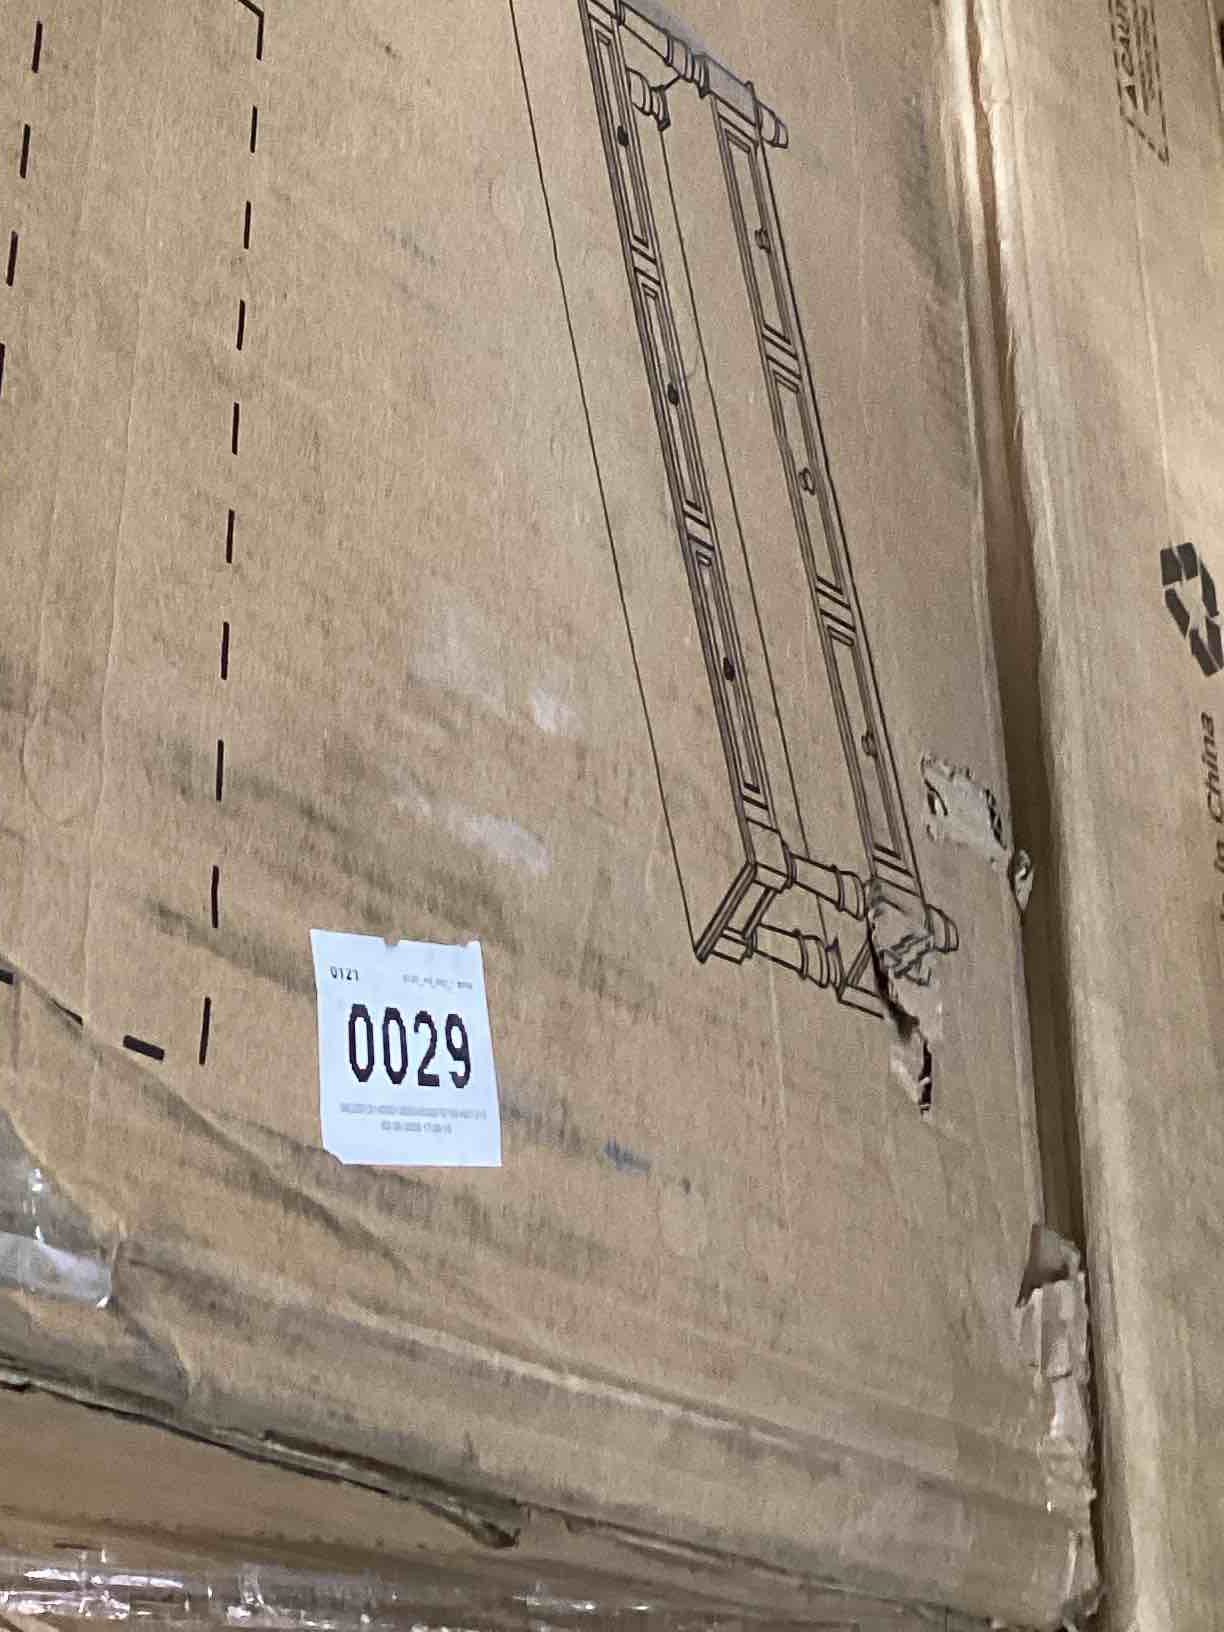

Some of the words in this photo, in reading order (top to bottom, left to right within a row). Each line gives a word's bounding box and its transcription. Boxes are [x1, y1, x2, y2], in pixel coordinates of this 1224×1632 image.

[1200, 711, 1224, 824] China
[329, 965, 360, 983] 0121
[347, 1002, 472, 1090] 0029
